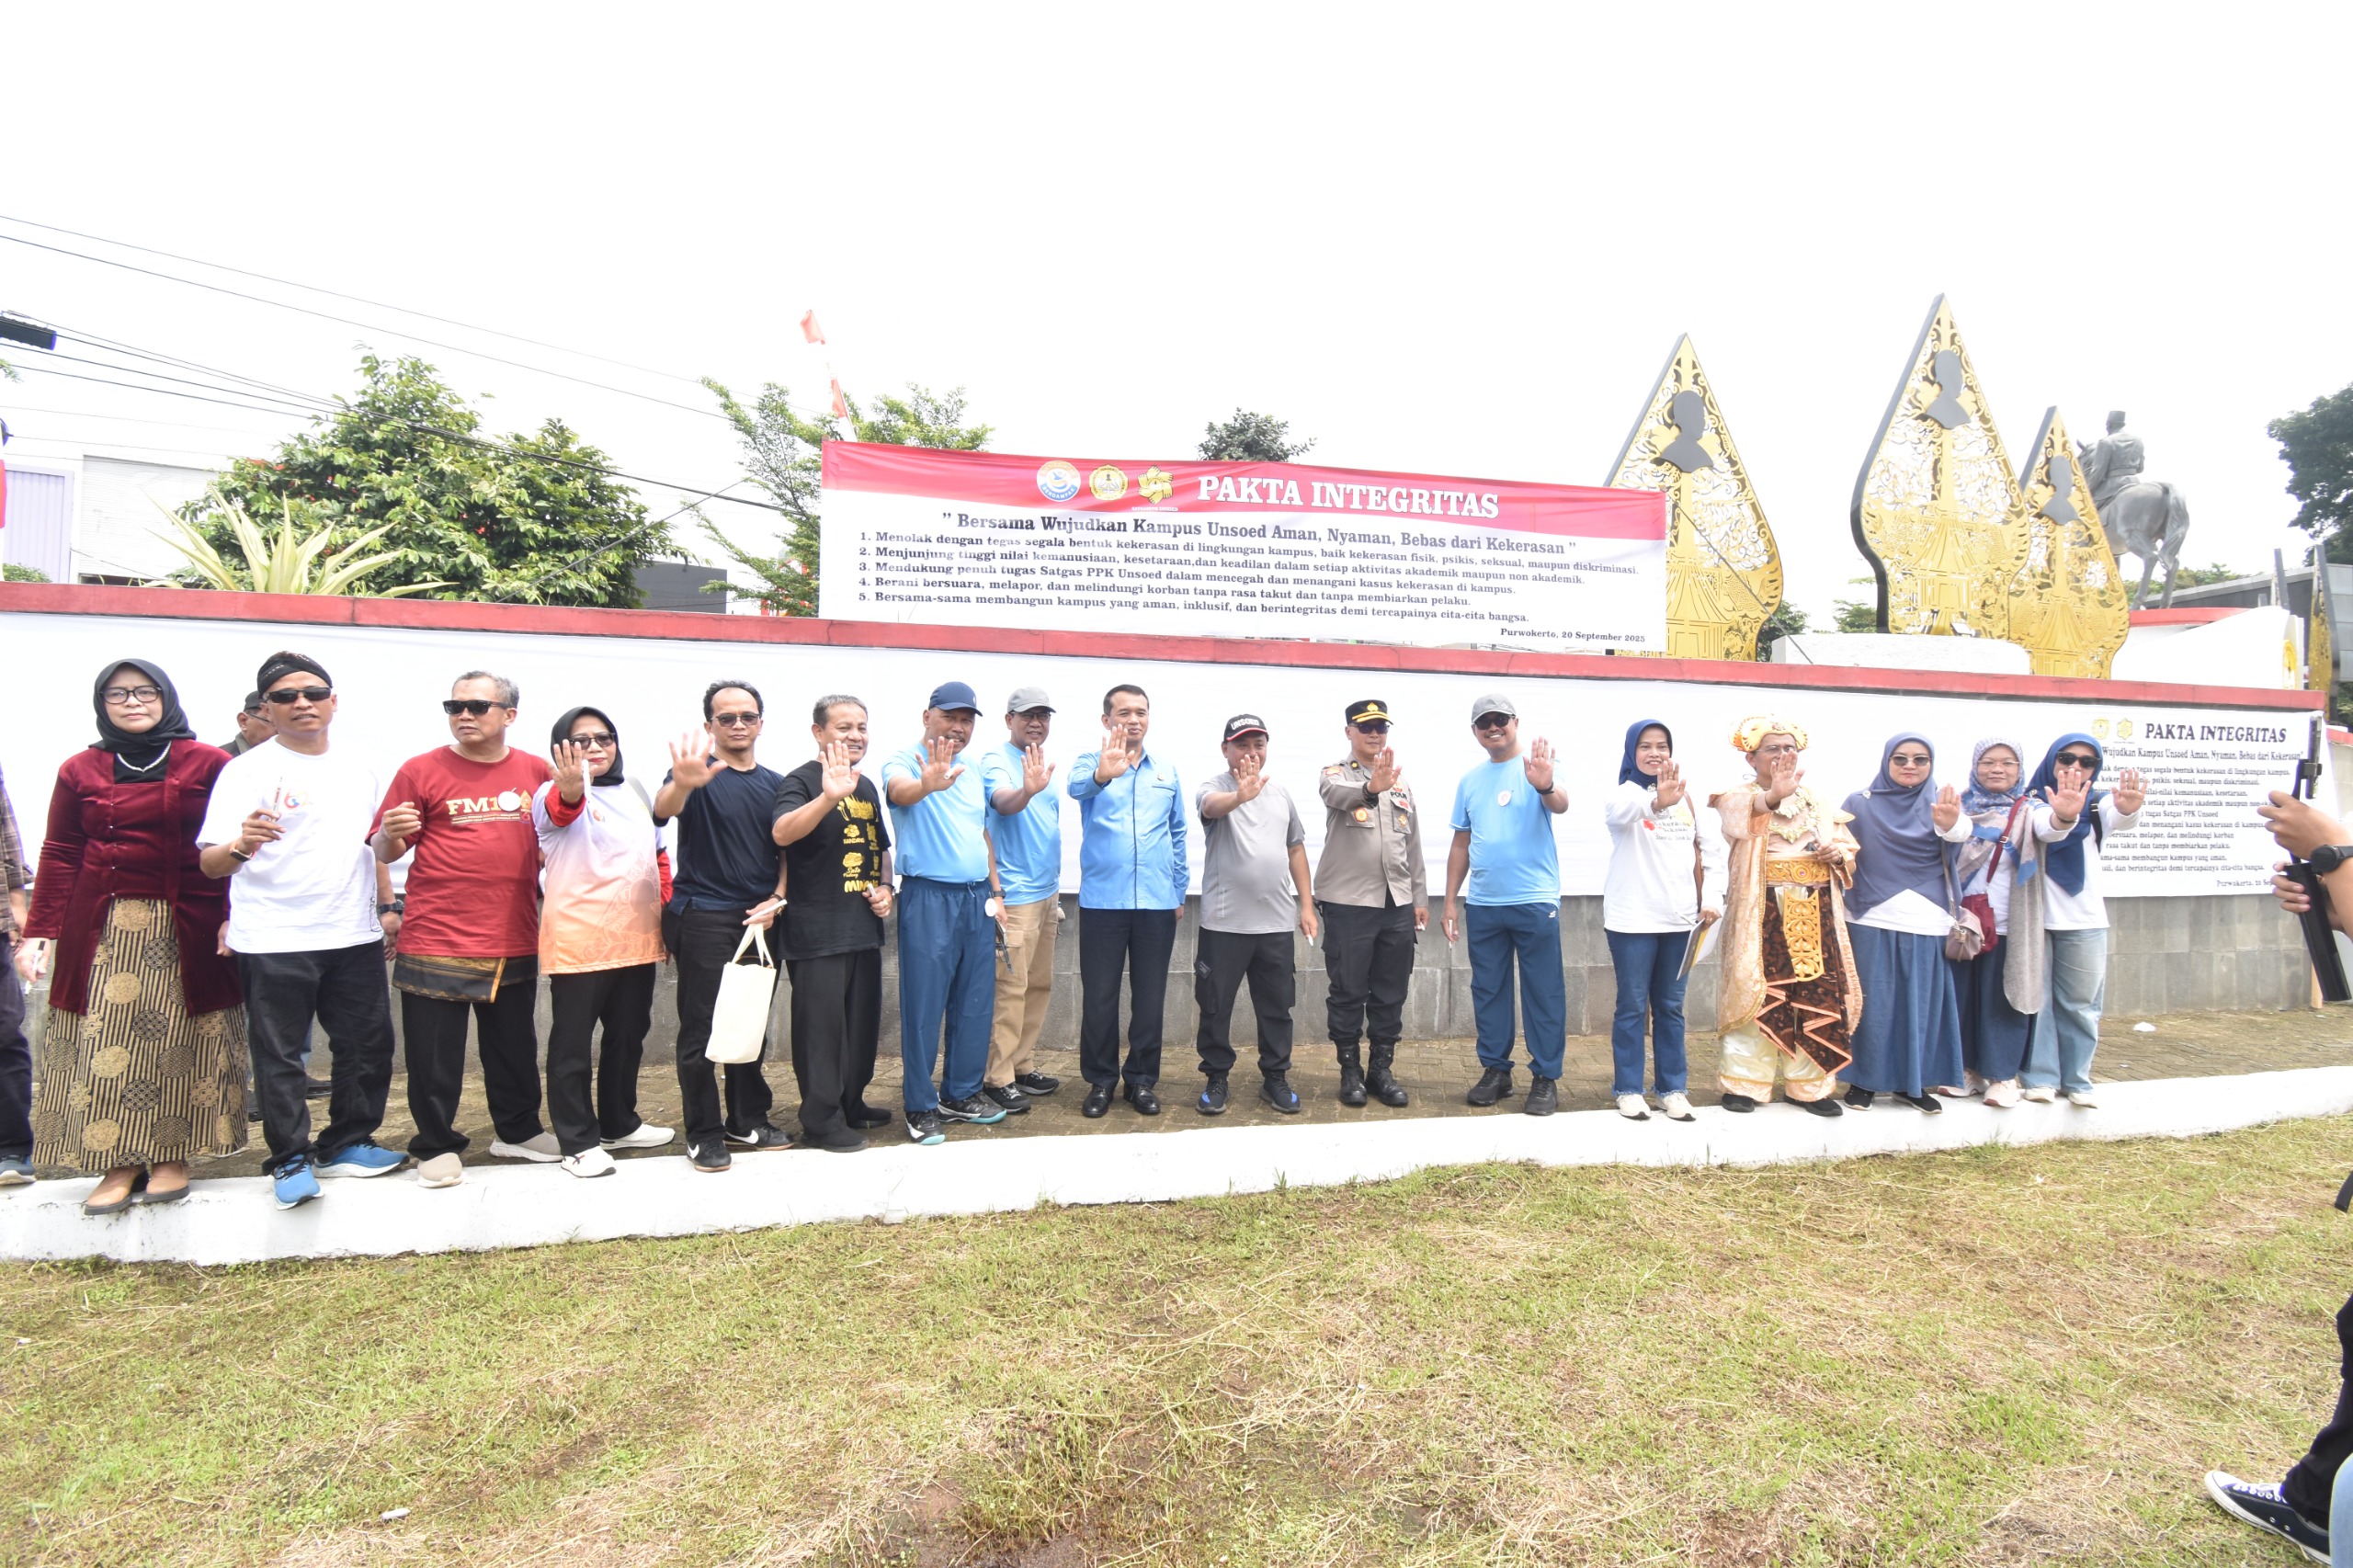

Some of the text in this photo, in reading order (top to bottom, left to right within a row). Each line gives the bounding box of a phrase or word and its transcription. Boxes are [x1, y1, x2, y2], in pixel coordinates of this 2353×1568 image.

[1197, 475, 1499, 519] PAKTA INTEGRITAS
[957, 513, 1564, 554] Bersama Wujudkan Kampus Unsoed Aman, Nyaman, Bebas dari Kekerasan
[859, 547, 870, 556] 2.
[875, 547, 954, 561] Menjunjung
[959, 550, 996, 562] tinggi
[1000, 551, 1029, 560] nilai
[1032, 551, 1120, 564] kemanusiaan,
[1221, 558, 1270, 569] keadilan
[1274, 561, 1310, 571] dalam
[1313, 562, 1348, 574] setiap
[1352, 564, 1402, 574] aktivitas
[1405, 567, 1459, 577] akademik
[1462, 572, 1506, 581] maupun
[1532, 574, 1585, 584] akademik.
[861, 531, 1638, 574] 1. Menolak dengan tegas segala bentuk kekerasan di lingkungan kampus, baik kekerasan fisik, psikis, seksual, maupun diskriminasi.
[858, 562, 1516, 596] 3. Mendukung penuh tugas Satgas PPK Unsoed dalam mencegah dan menangani kasus kekerasan di kampus.
[858, 577, 870, 586] 4.
[875, 577, 918, 586] Berani
[923, 578, 984, 590] bersuara,
[989, 580, 1042, 592] melapor,
[1047, 582, 1070, 591] dan
[1074, 583, 1143, 596] melindungi
[1147, 585, 1189, 595] korban
[1193, 586, 1227, 598] tanpa
[1260, 589, 1292, 598] takut
[1296, 590, 1317, 599] dan
[1321, 592, 1354, 603] tanpa
[1358, 593, 1427, 604] membiarkan
[1431, 596, 1471, 607] pelaku.
[858, 592, 1529, 623] 5. Bersama-sama membangun kampus yang aman, inklusif, dan berintegritas demi tercapainya cita-cita bangsa.
[1500, 628, 1558, 639] Purwokerto,
[1575, 631, 1622, 642] September
[1230, 718, 1260, 731] UNSOED
[2145, 723, 2287, 743] PAKTA INTEGRITAS
[2102, 747, 2136, 758] Wujudkan
[2138, 748, 2164, 759] Kampus
[2165, 749, 2188, 758] Unsoed
[2239, 751, 2256, 760] Bebas
[2257, 752, 2269, 760] dari
